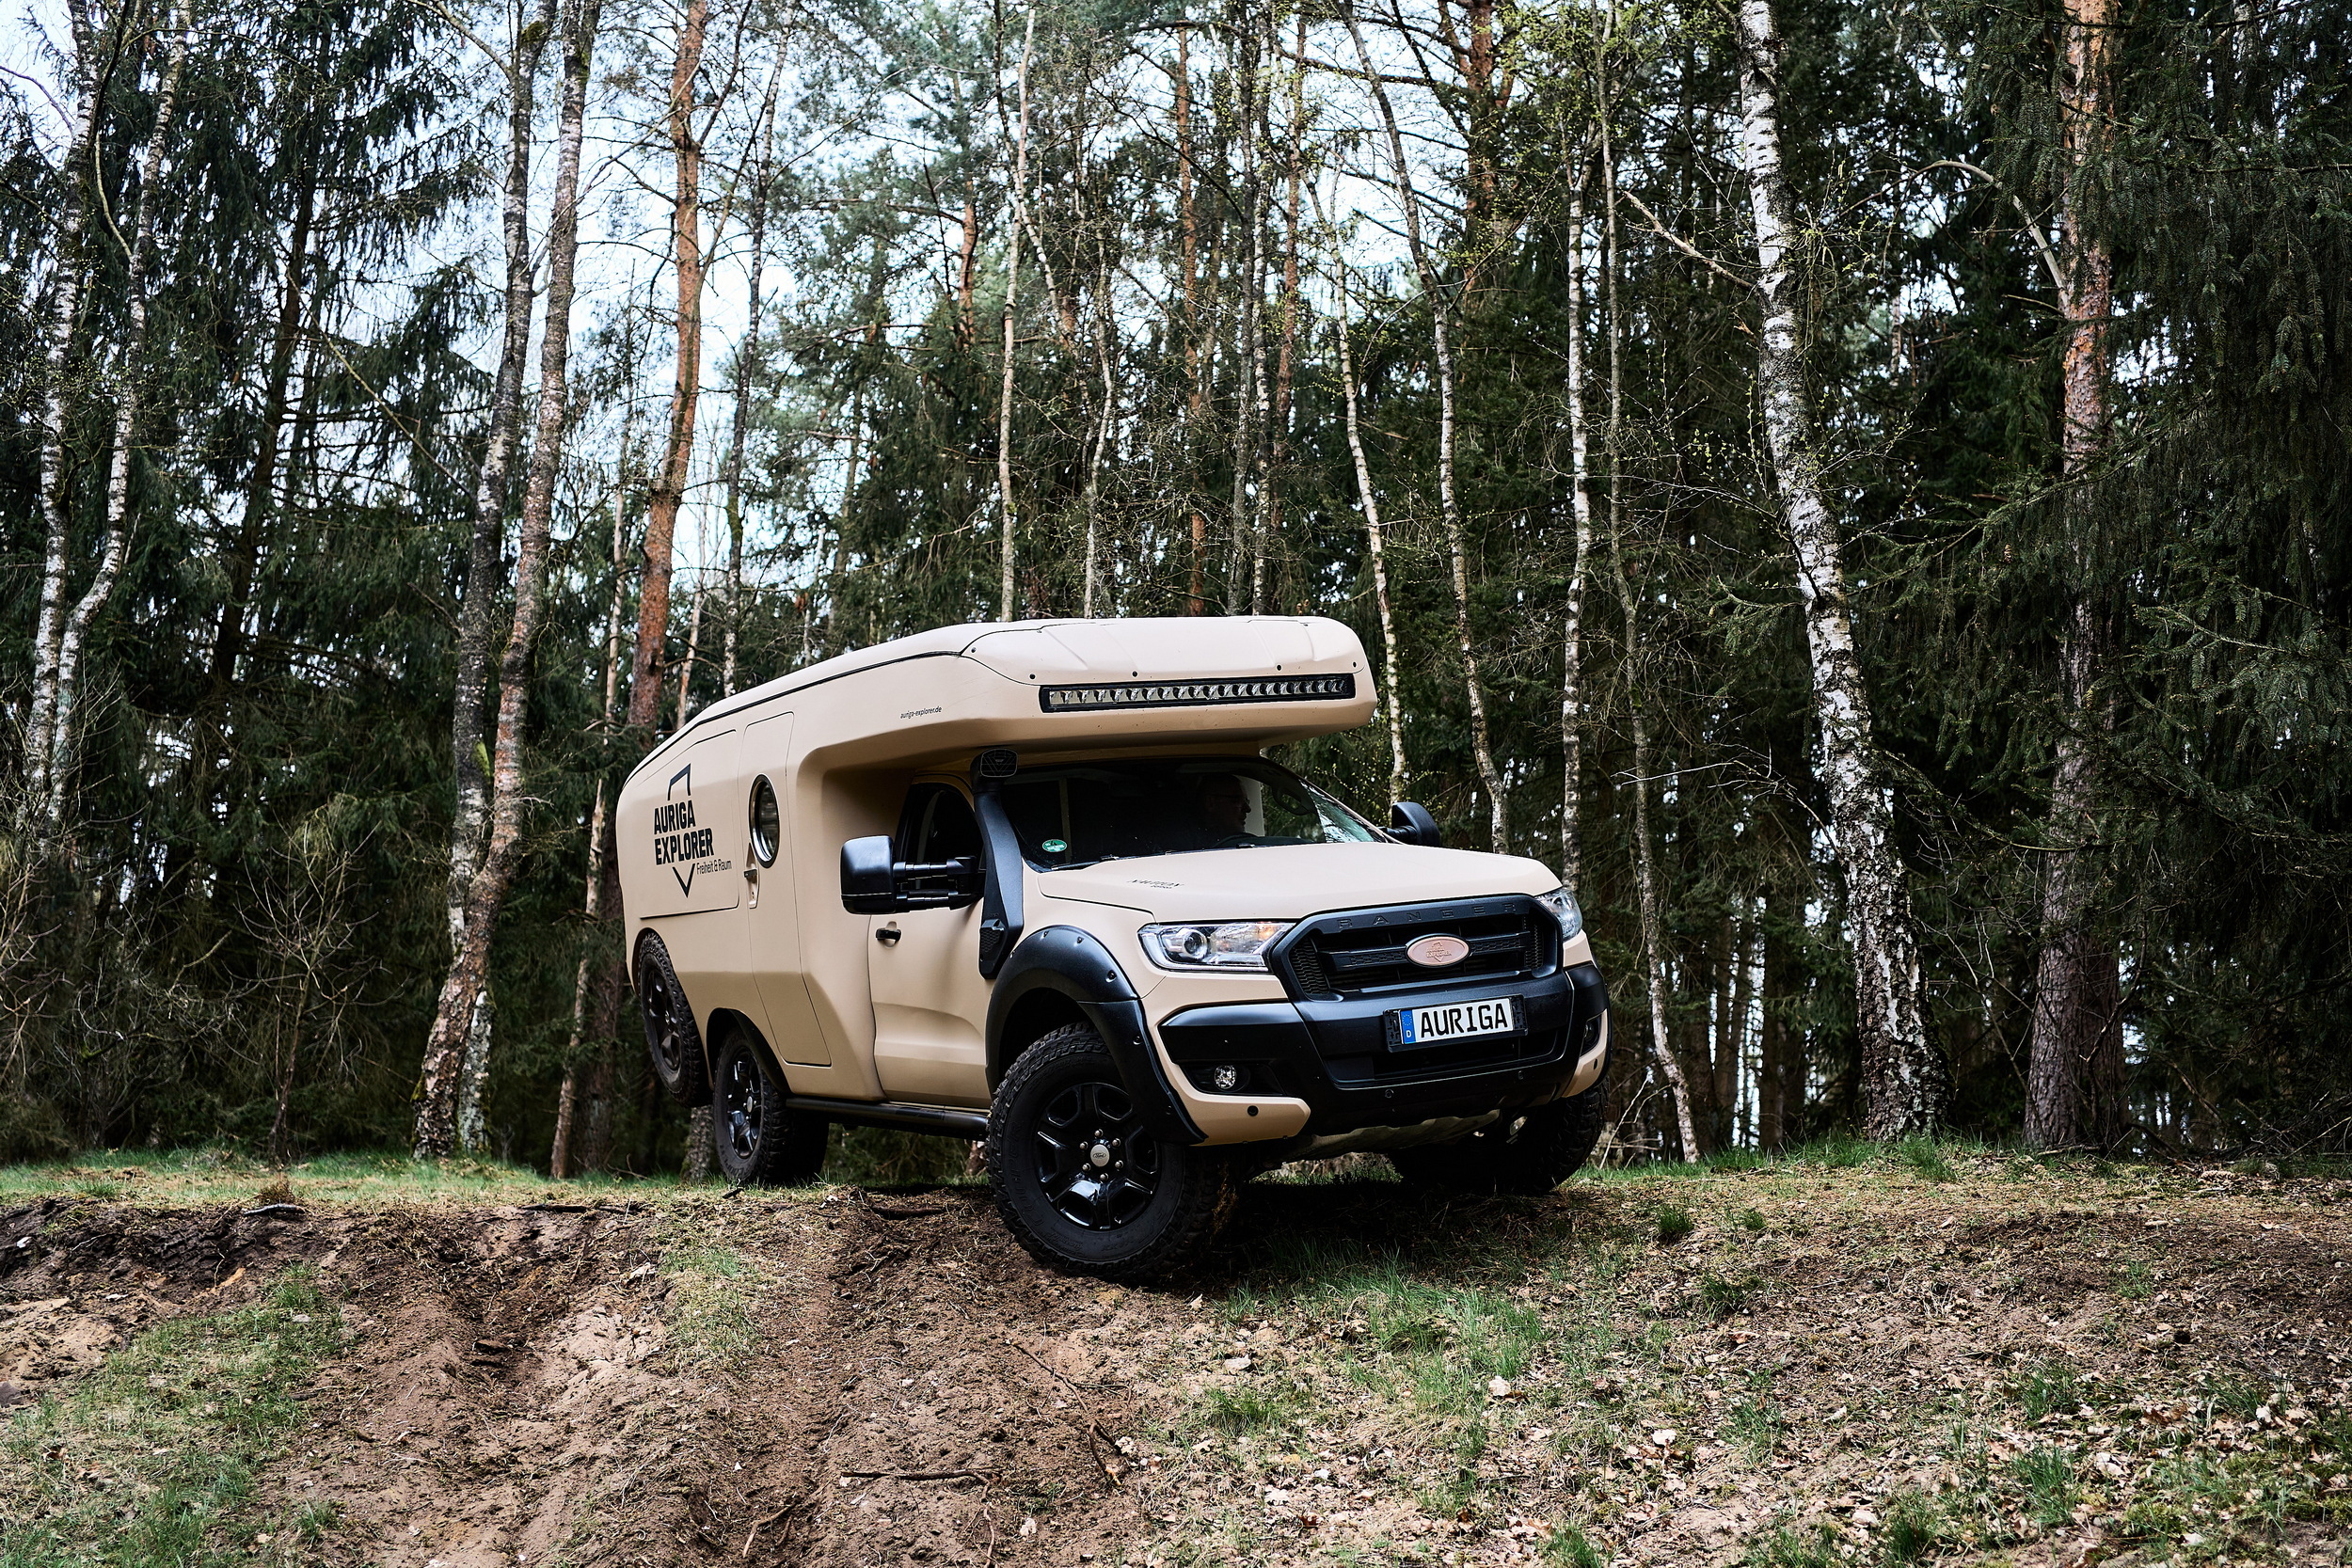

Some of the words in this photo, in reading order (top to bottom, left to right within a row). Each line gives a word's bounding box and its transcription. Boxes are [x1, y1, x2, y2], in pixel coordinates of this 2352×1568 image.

[900, 705, 942, 719] auriga-explorer.de
[654, 800, 696, 835] AURIGA
[655, 828, 714, 865] EXPLORER
[696, 862, 713, 875] Freiheit
[718, 858, 732, 871] Raum
[1337, 902, 1517, 928] RANGER
[1421, 1003, 1507, 1038] AURIGA
